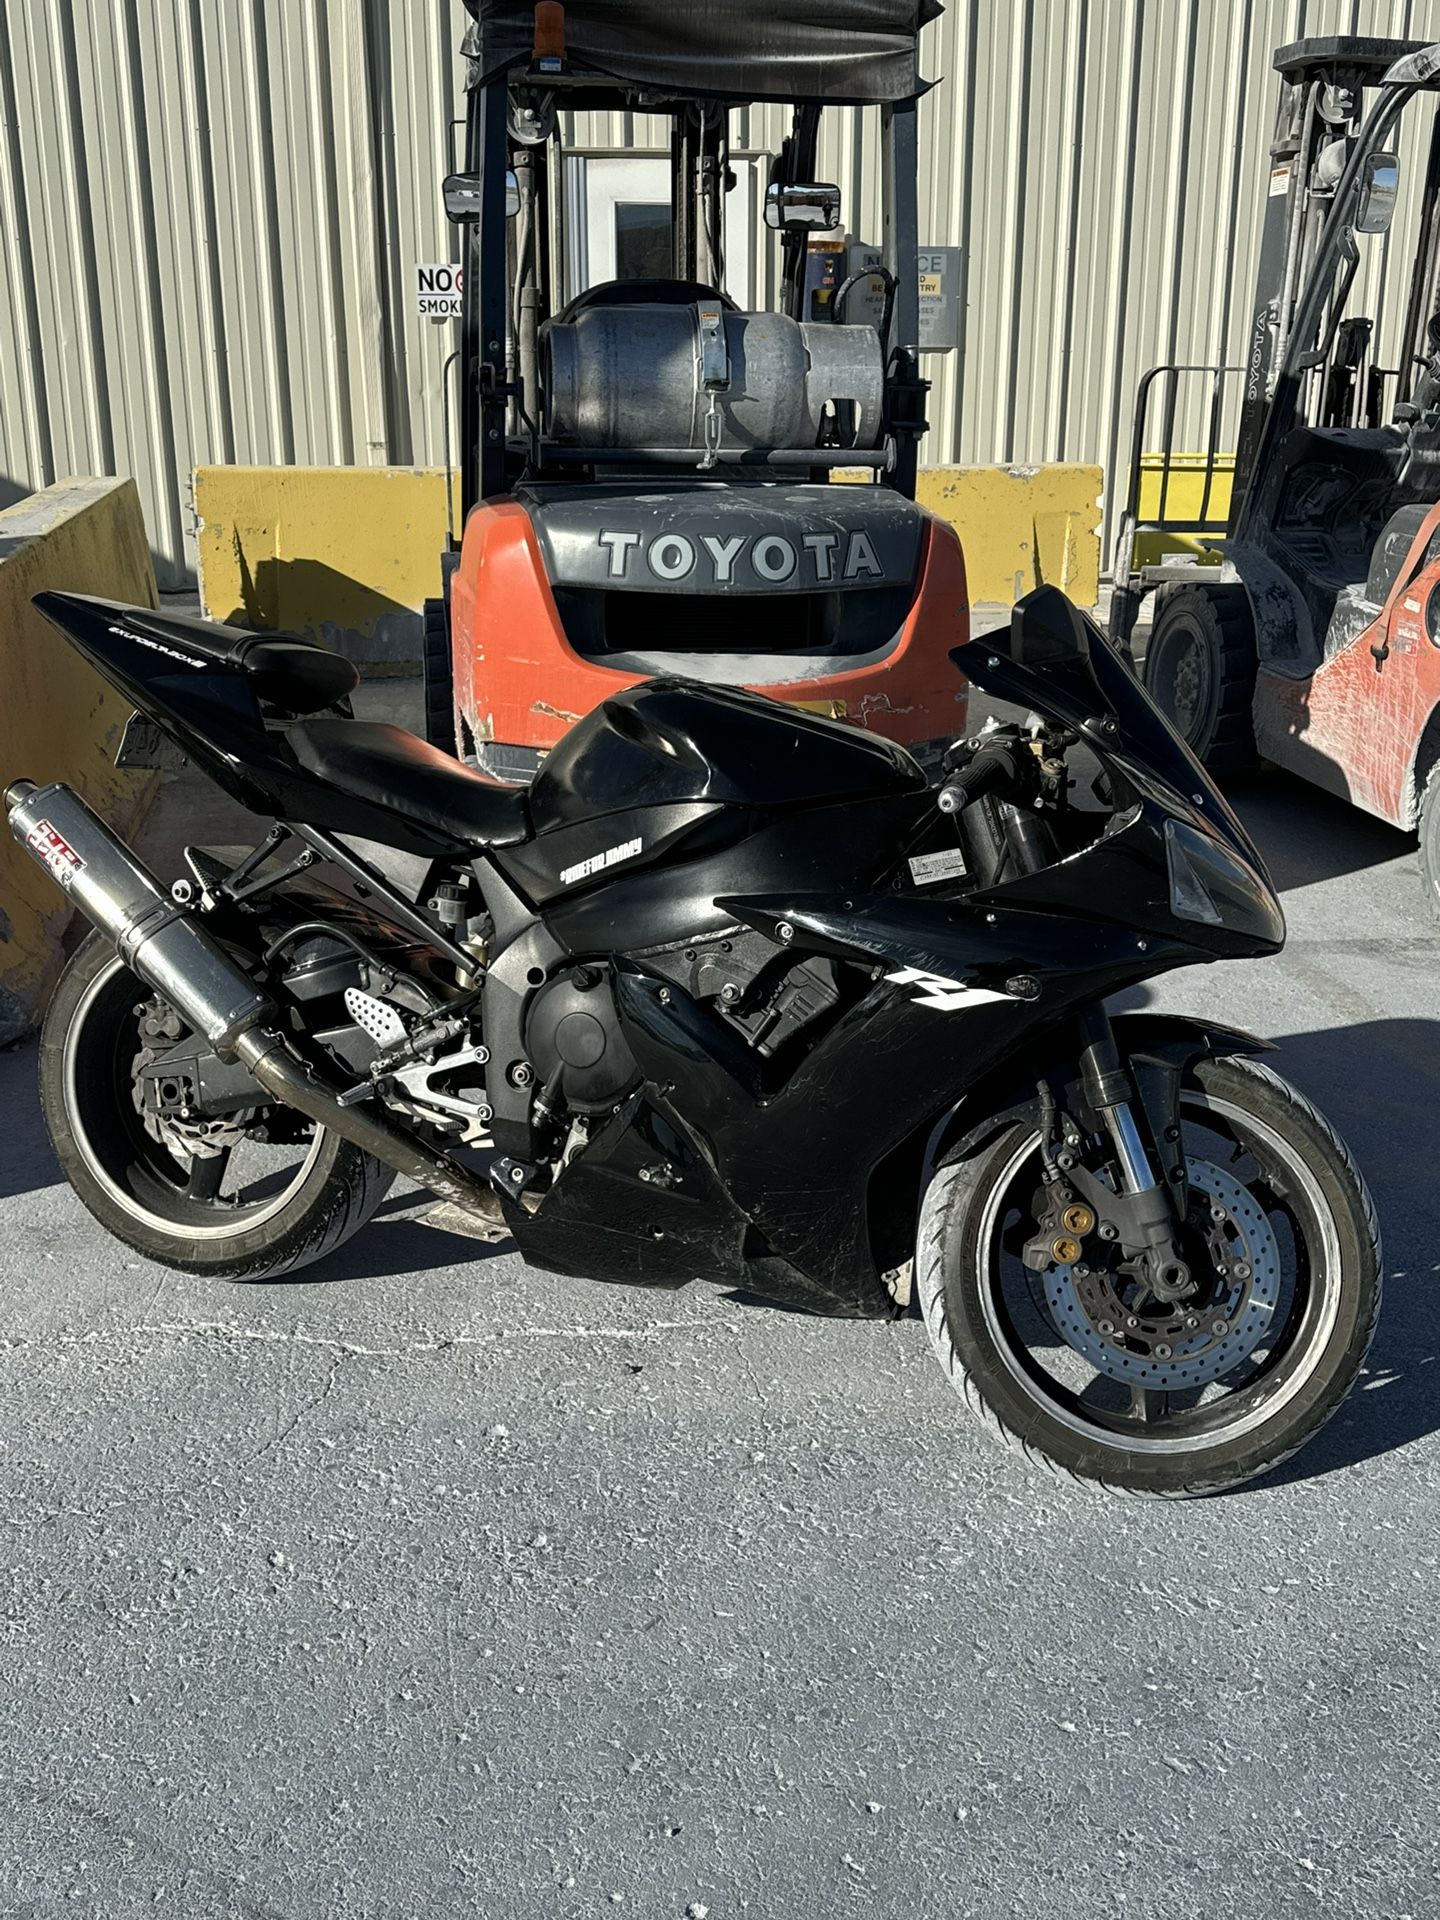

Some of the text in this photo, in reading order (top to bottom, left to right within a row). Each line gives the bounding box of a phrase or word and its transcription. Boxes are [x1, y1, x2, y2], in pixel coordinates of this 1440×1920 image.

[866, 255, 942, 273] NCE
[418, 268, 453, 292] NO
[919, 284, 937, 292] TRY
[1246, 310, 1268, 421] TOYOTA
[600, 530, 884, 581] TOYOTA
